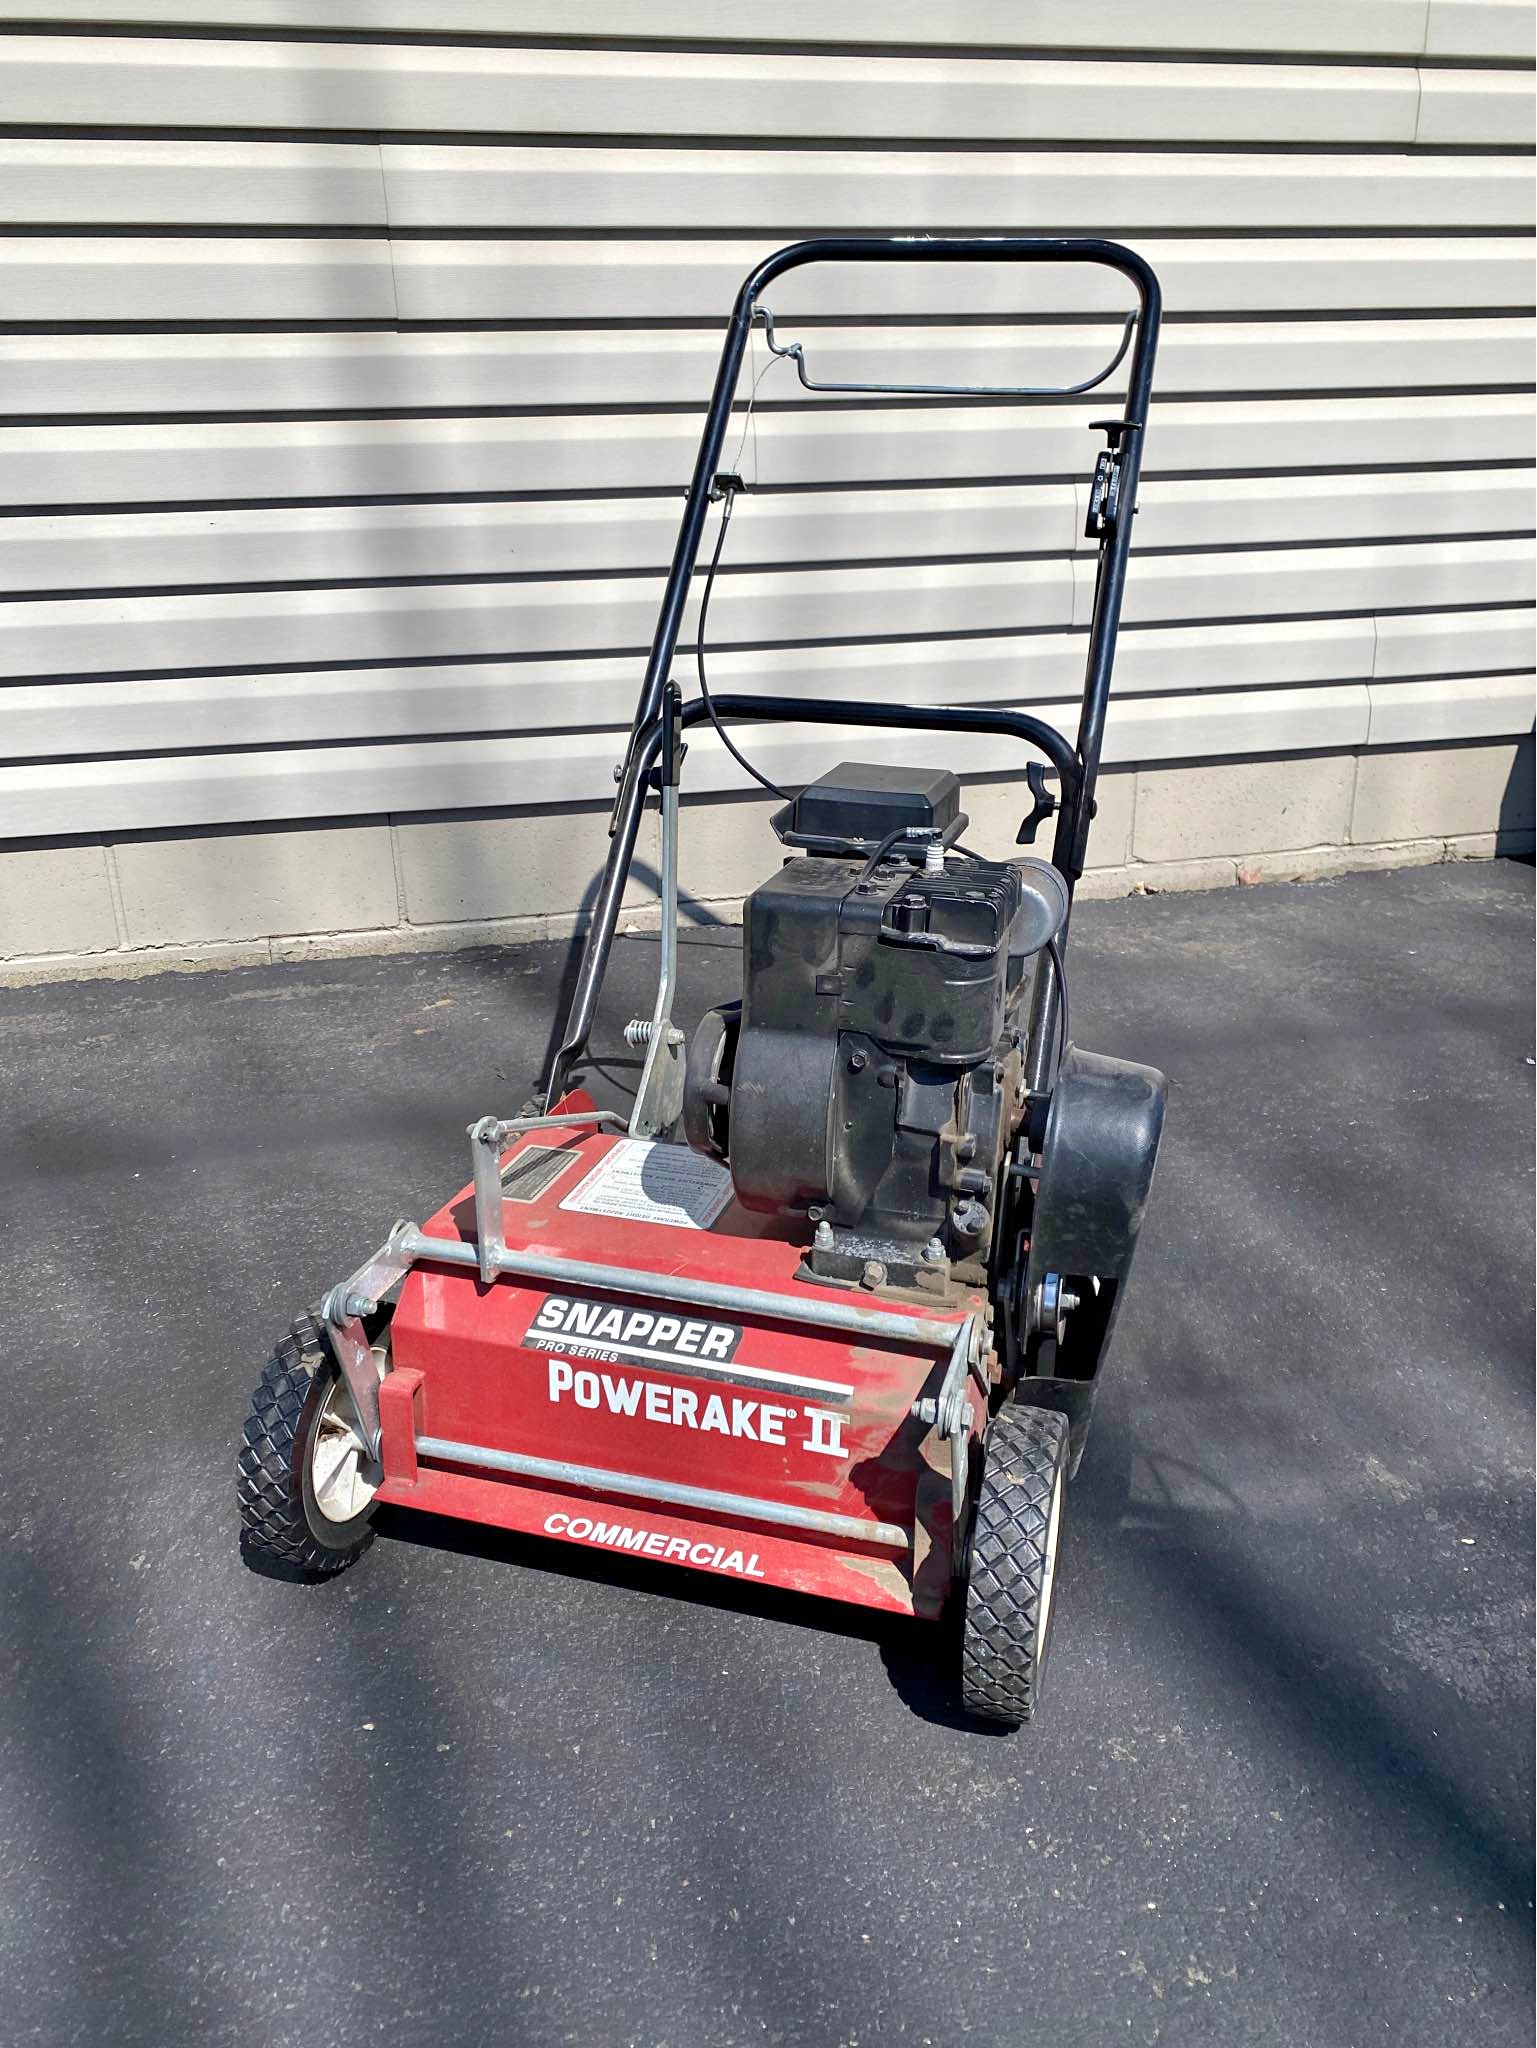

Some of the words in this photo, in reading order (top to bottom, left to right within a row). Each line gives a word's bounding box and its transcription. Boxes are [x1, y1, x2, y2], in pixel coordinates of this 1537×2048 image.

[536, 1299, 735, 1359] SNAPPER
[536, 1340, 566, 1353] PRO
[568, 1345, 619, 1363] SERIES
[803, 1406, 850, 1458] II
[543, 1513, 766, 1578] COMMERCIAL
